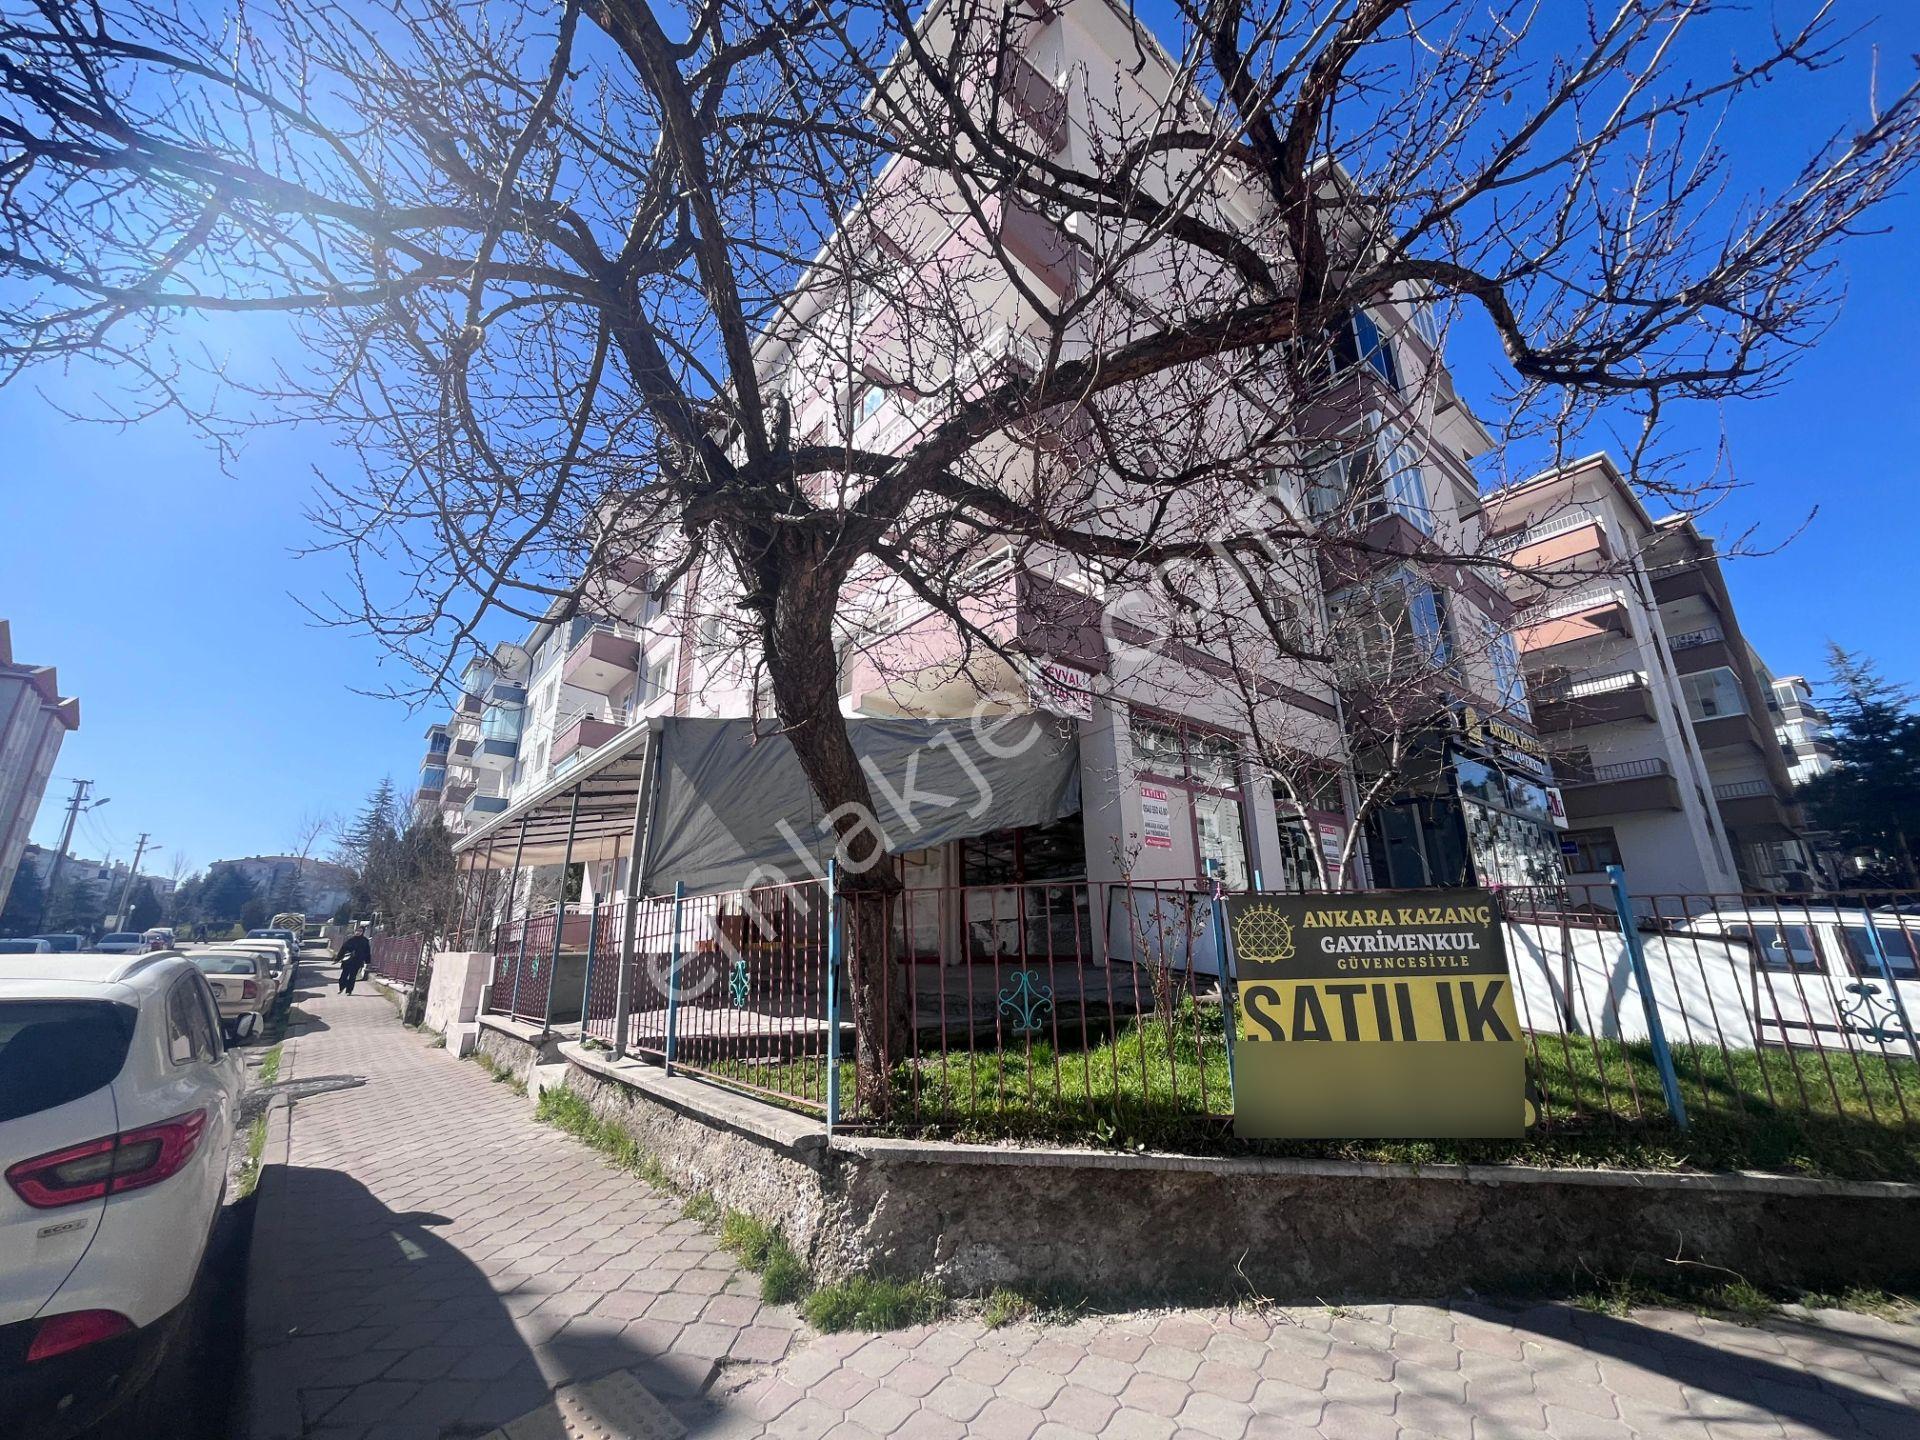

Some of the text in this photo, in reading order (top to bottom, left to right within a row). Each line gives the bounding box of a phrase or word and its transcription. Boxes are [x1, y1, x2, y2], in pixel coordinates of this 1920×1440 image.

[1302, 906, 1491, 929] ANKARA KAZANÇ
[1320, 929, 1480, 953] GAYRİMENKUL
[1337, 953, 1470, 970] GÜVENCESİYLE
